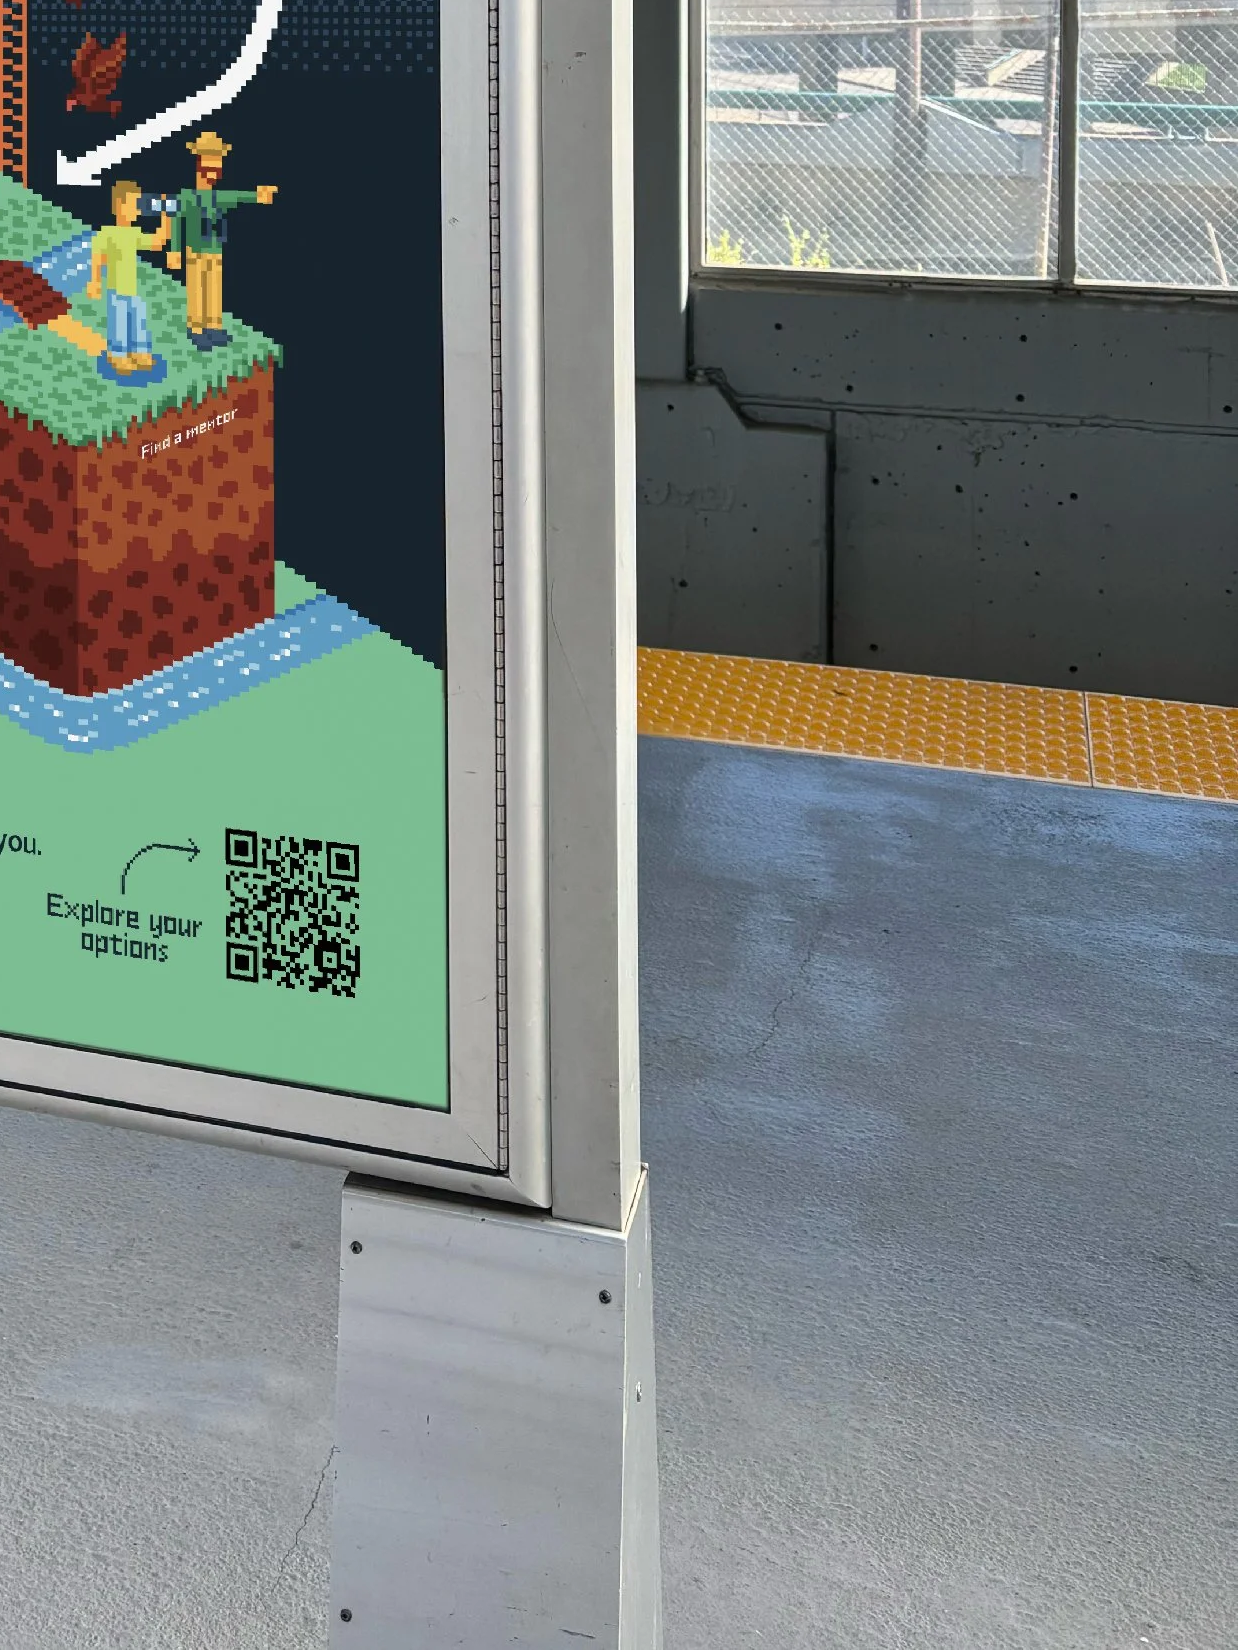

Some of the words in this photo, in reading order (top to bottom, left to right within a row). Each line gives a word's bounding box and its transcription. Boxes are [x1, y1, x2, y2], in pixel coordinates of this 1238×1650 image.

[141, 435, 171, 460] Find
[174, 432, 182, 445] a
[186, 408, 238, 440] mentor
[47, 892, 139, 929] Explore
[150, 914, 202, 939] your
[81, 932, 169, 963] options
